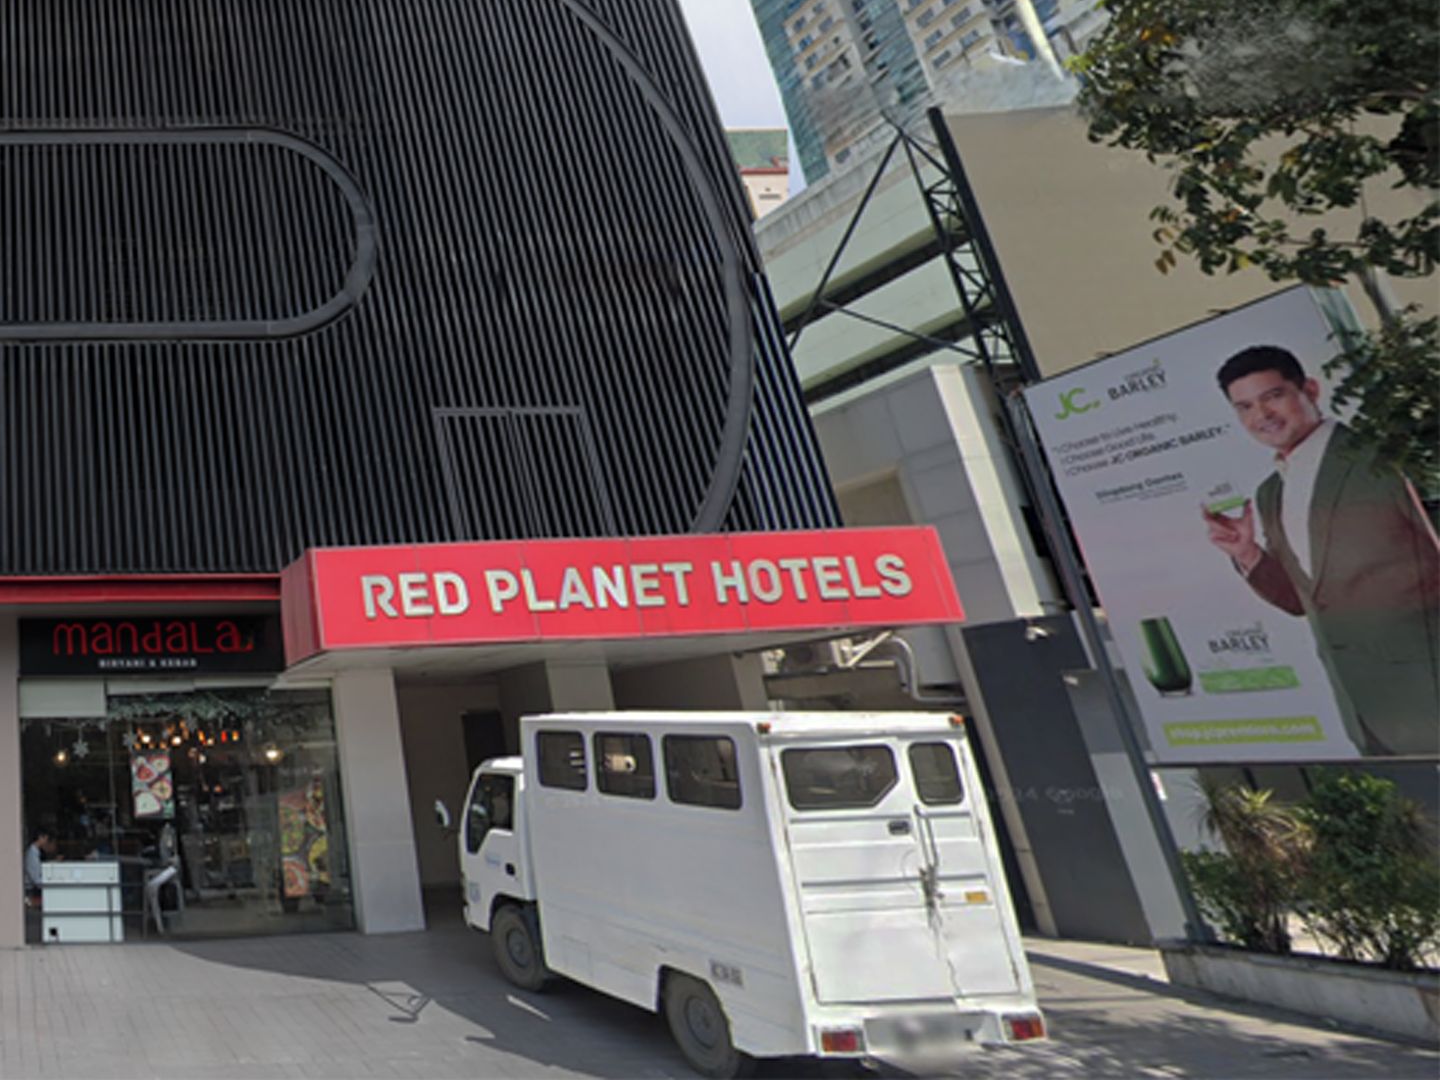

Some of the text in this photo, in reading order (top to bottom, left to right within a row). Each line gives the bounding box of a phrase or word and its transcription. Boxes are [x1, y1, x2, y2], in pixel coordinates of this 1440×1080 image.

[1107, 370, 1168, 401] BARLEY
[361, 554, 913, 619] RED PLANET HOTELS
[1208, 634, 1271, 654] BARLEY
